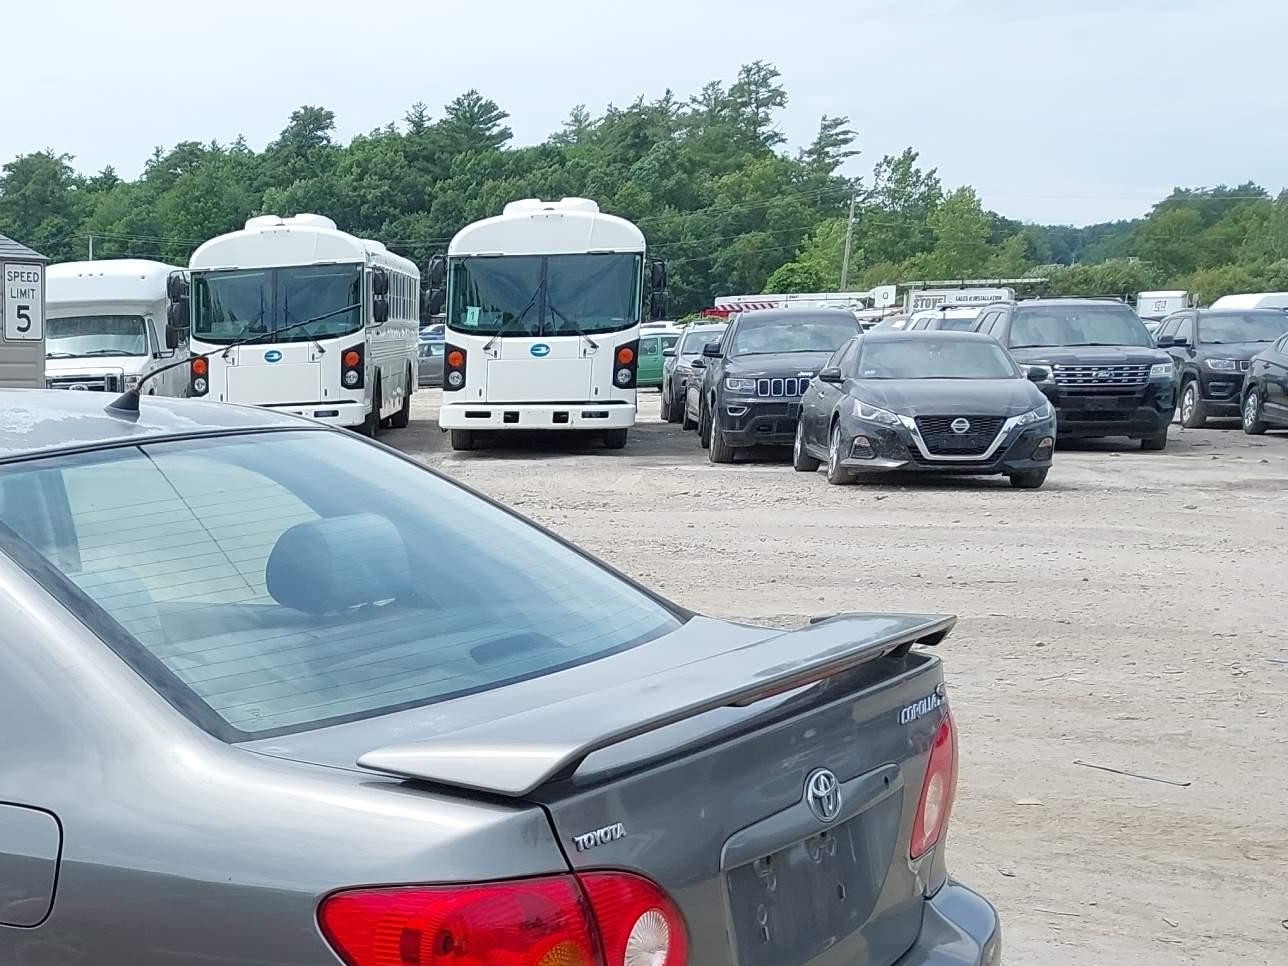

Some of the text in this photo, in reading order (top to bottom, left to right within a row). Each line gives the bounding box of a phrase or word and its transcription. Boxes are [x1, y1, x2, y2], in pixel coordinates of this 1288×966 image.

[7, 271, 40, 283] SPEED
[10, 288, 36, 299] LIMIT
[16, 304, 31, 333] 5
[573, 821, 627, 852] TOYOTA
